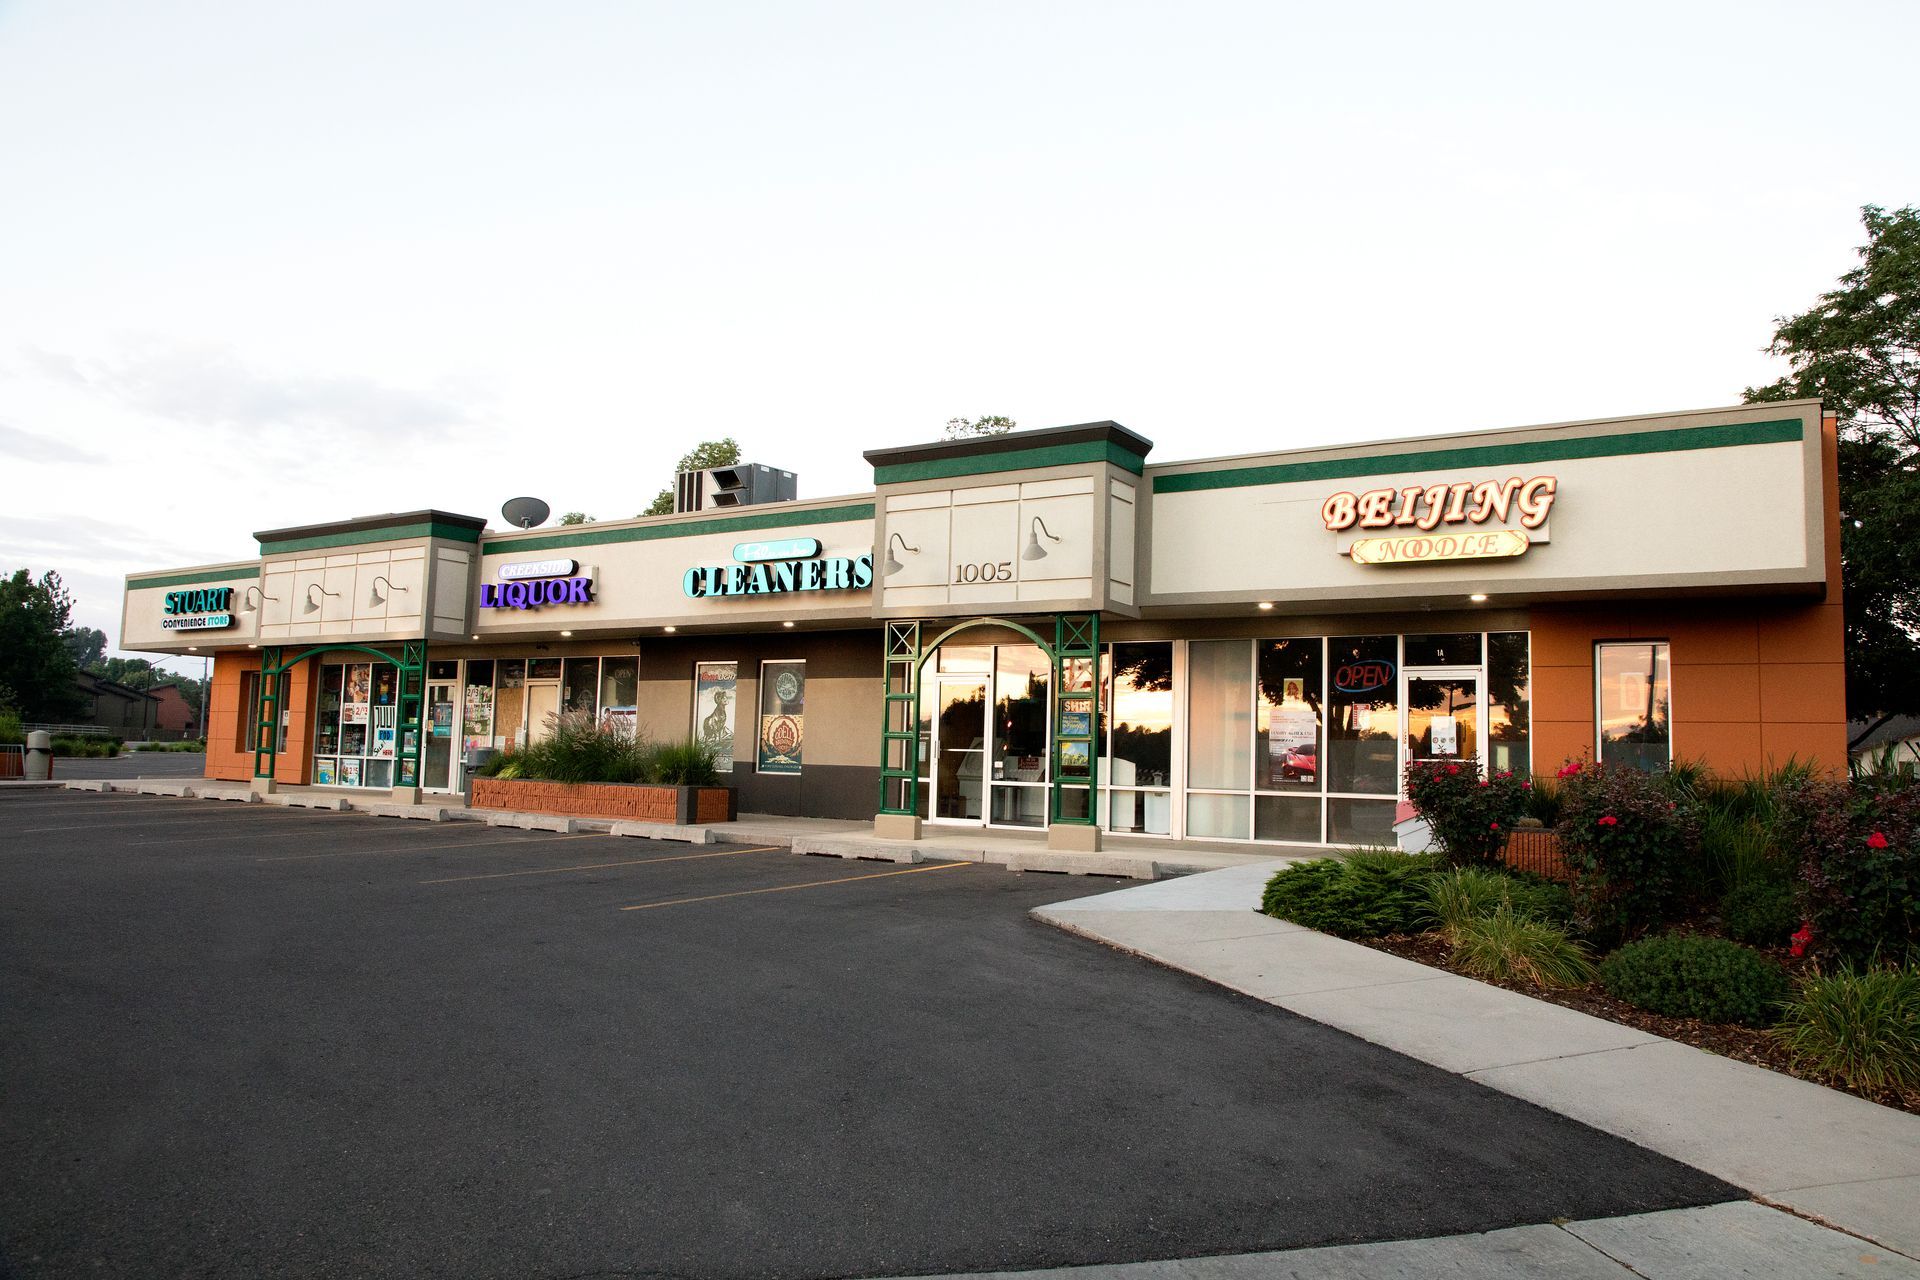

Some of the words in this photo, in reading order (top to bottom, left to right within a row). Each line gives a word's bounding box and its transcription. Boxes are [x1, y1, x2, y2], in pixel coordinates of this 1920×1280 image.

[1322, 476, 1557, 530] BEIJING
[1378, 534, 1499, 562] NOODLE
[501, 561, 569, 577] CREEKSIDE
[683, 554, 873, 598] CLEANERS
[955, 561, 1012, 583] 1005
[164, 587, 230, 615] STUART
[480, 577, 590, 610] LIQUOR
[163, 617, 206, 629] CONVENIENCE
[207, 615, 228, 626] STORE
[1437, 649, 1444, 657] 1A
[1335, 665, 1390, 687] OPEN
[1064, 700, 1104, 713] SHIRS
